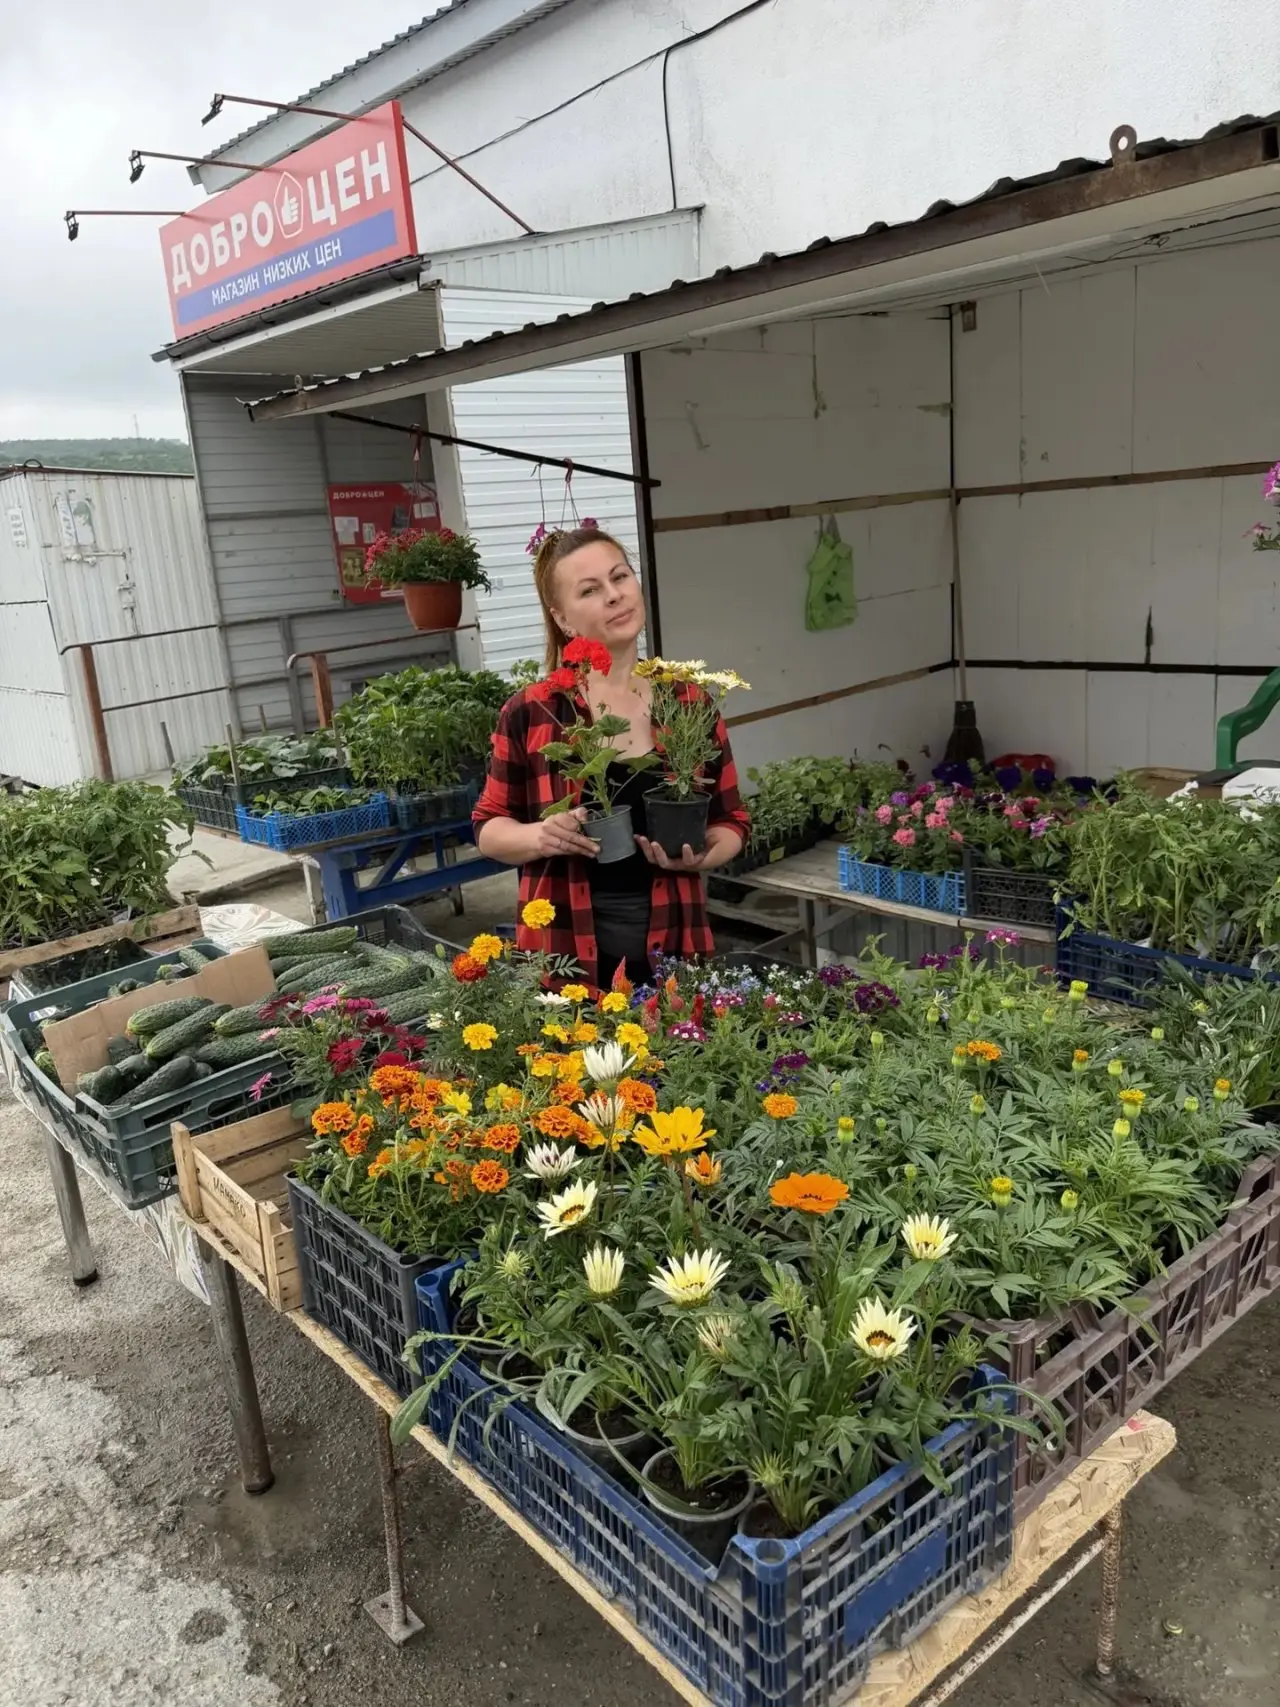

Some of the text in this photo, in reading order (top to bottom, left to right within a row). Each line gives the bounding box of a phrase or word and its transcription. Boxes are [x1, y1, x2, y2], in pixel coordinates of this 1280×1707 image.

[170, 141, 391, 294] ДОБРО ЦЕН
[211, 238, 342, 307] МАГАЗИН НИЗКИХ ЦЕН
